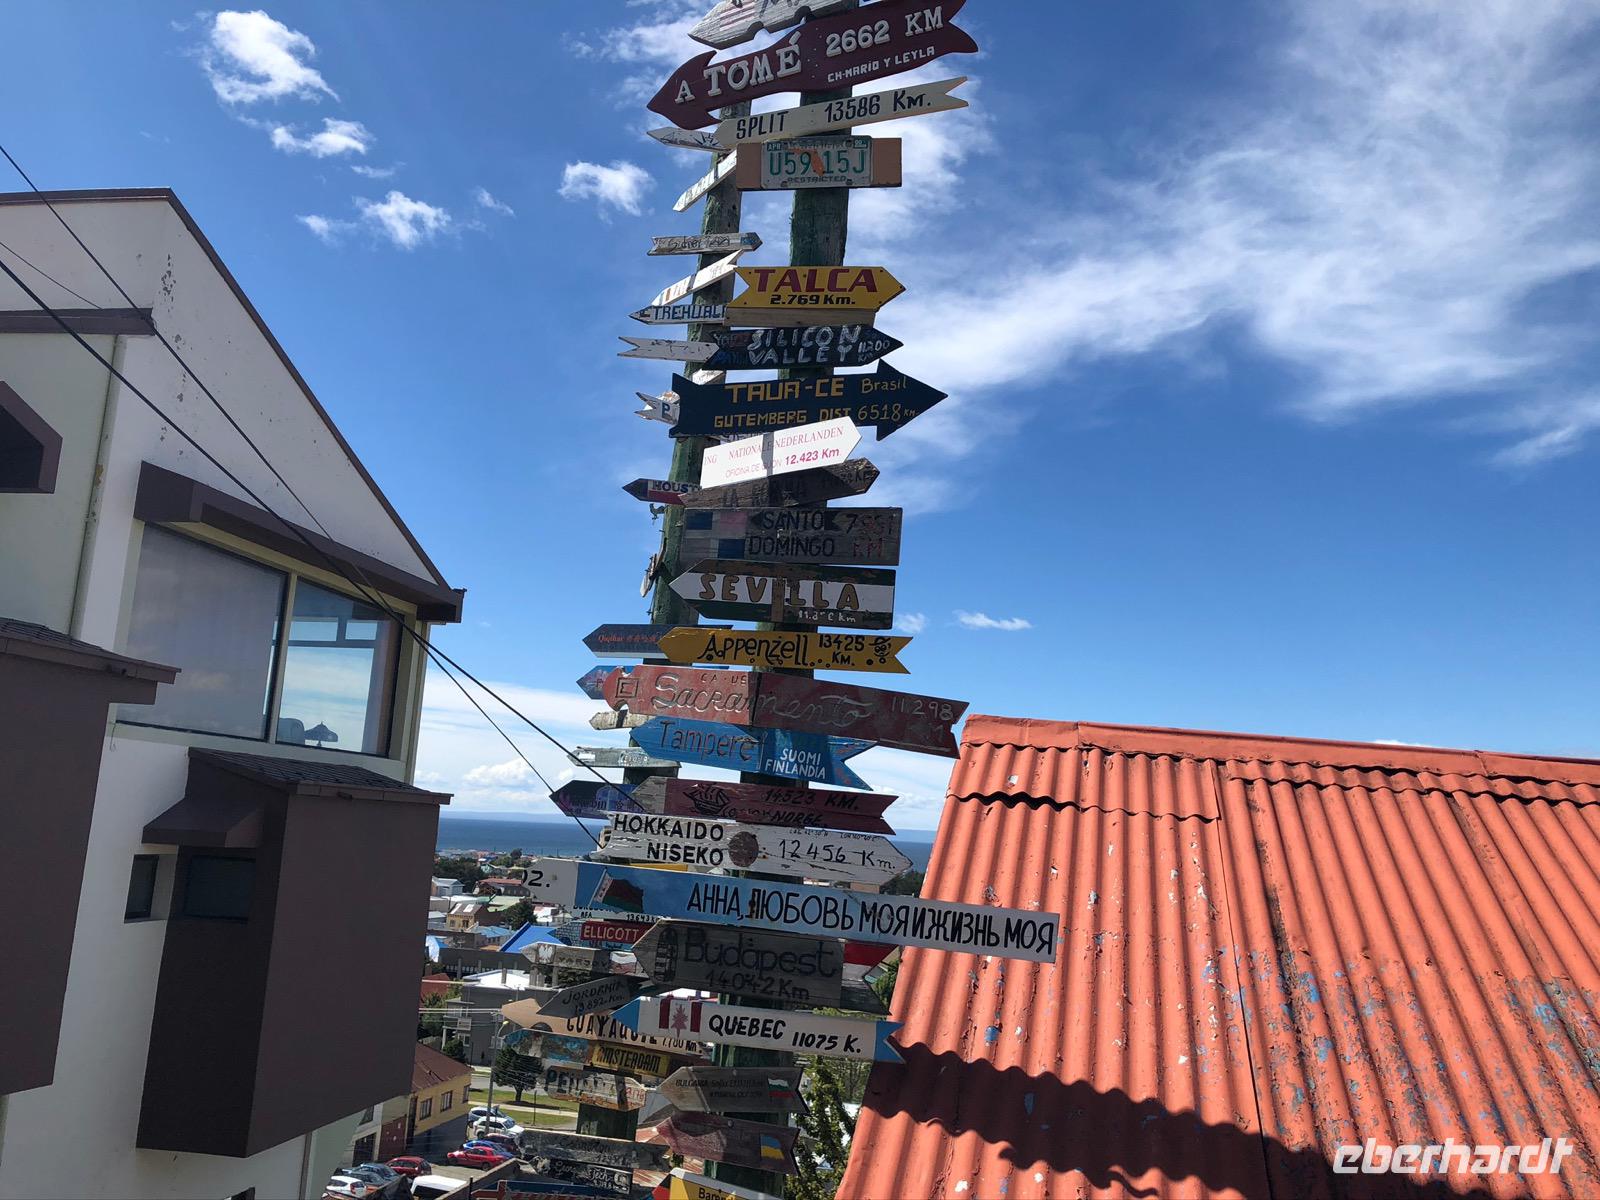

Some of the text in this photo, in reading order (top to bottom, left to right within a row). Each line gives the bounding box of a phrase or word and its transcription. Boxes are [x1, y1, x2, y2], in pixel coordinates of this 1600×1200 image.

[825, 6, 944, 57] 2662 KM
[675, 31, 800, 104] A TOMÉ
[895, 46, 935, 65] LEYLA
[736, 111, 789, 140] SPLIT
[825, 94, 880, 123] 13586
[754, 268, 878, 293] TALCA
[770, 294, 856, 305] 2.769 Km.
[748, 325, 861, 350] SILICON
[749, 344, 852, 366] VALLEY
[861, 378, 907, 394] Brasil
[714, 410, 807, 428] GUTEMBERG
[858, 403, 901, 421] 6518
[774, 426, 844, 449] NEDERLANDEN
[785, 450, 819, 466] 12.423
[821, 447, 840, 459] Km
[763, 511, 825, 531] SANTO
[749, 535, 835, 558] DOMINGO
[698, 634, 865, 667] Appenzell 13425
[650, 671, 873, 727] Sacramento
[660, 720, 758, 761] Tampere
[765, 758, 827, 780] FINLANDIA
[779, 748, 821, 766] SUOMI
[614, 814, 725, 841] HOKKAIDO
[647, 842, 724, 866] NISEKO
[583, 925, 640, 942] ELLICOTT
[1003, 916, 1056, 956] МОЯ
[708, 1014, 787, 1040] QUEBEC
[792, 1031, 838, 1051] 11075
[595, 1045, 662, 1074] AMSTERDAM
